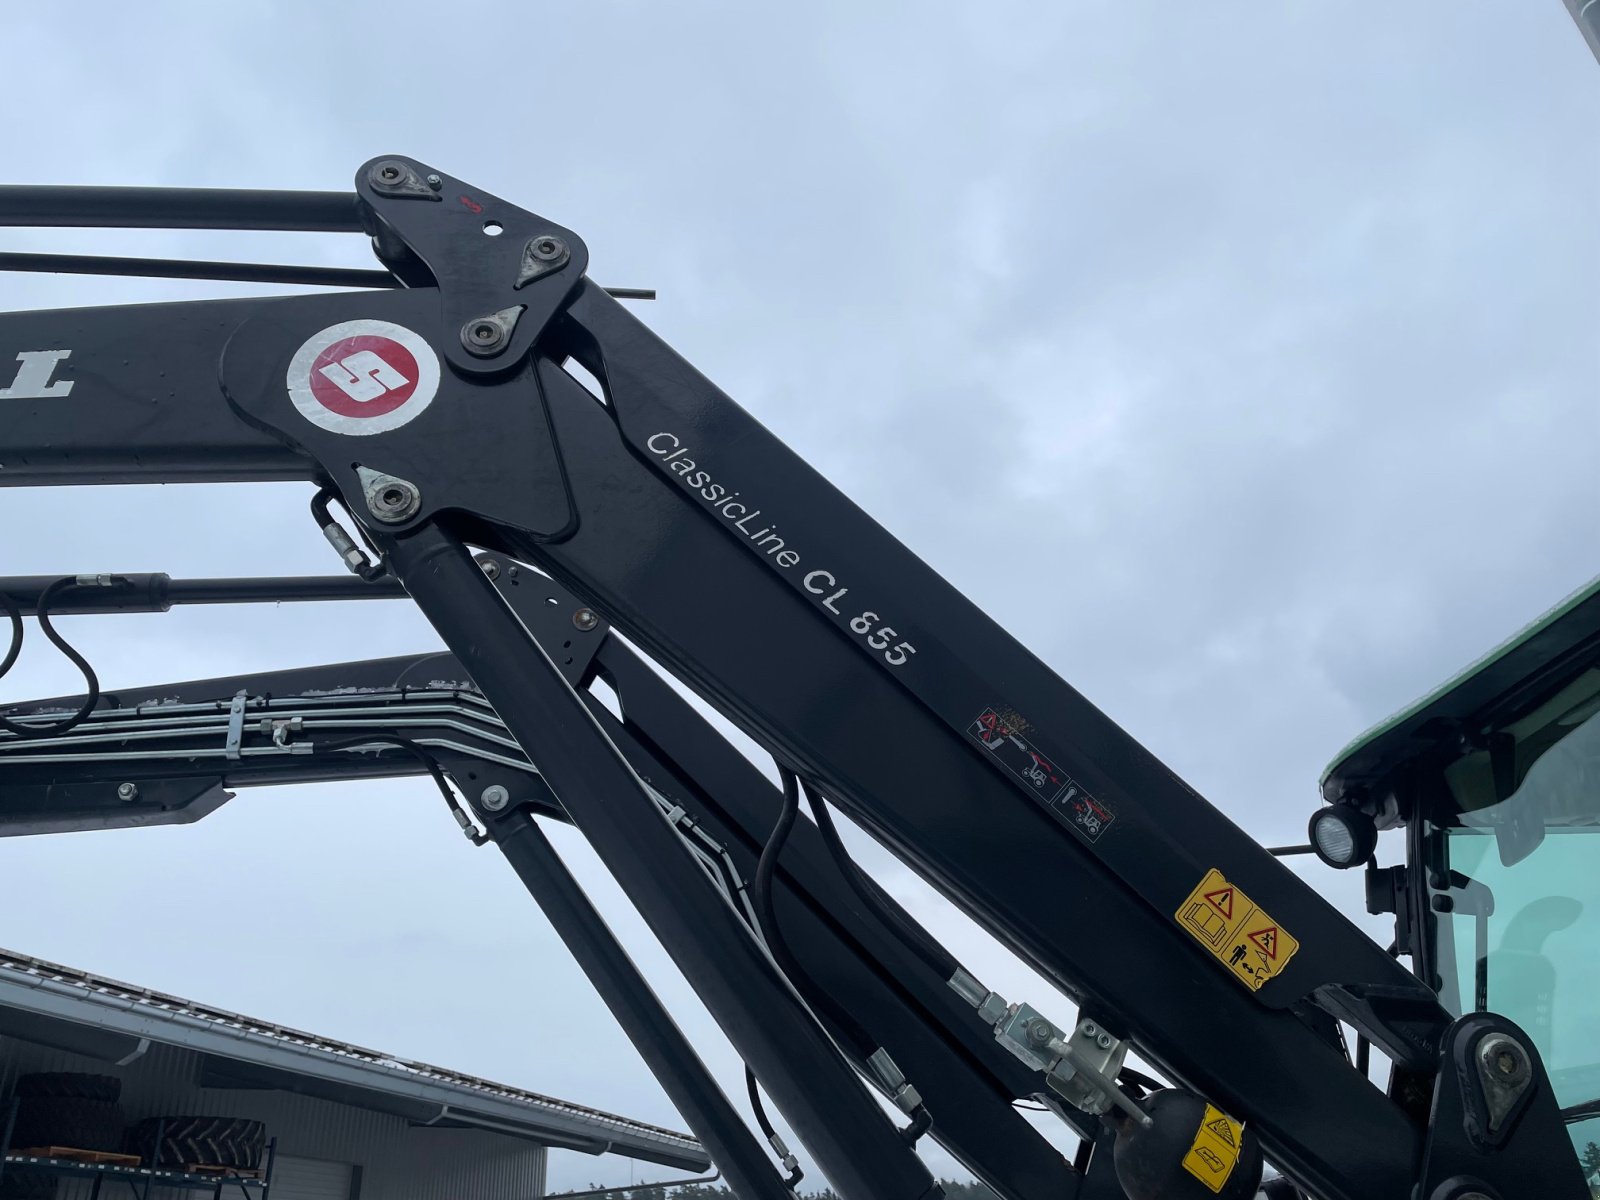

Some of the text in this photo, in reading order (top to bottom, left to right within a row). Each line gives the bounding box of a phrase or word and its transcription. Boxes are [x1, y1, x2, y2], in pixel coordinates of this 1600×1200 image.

[647, 432, 917, 666] ClassicLine CL 855
